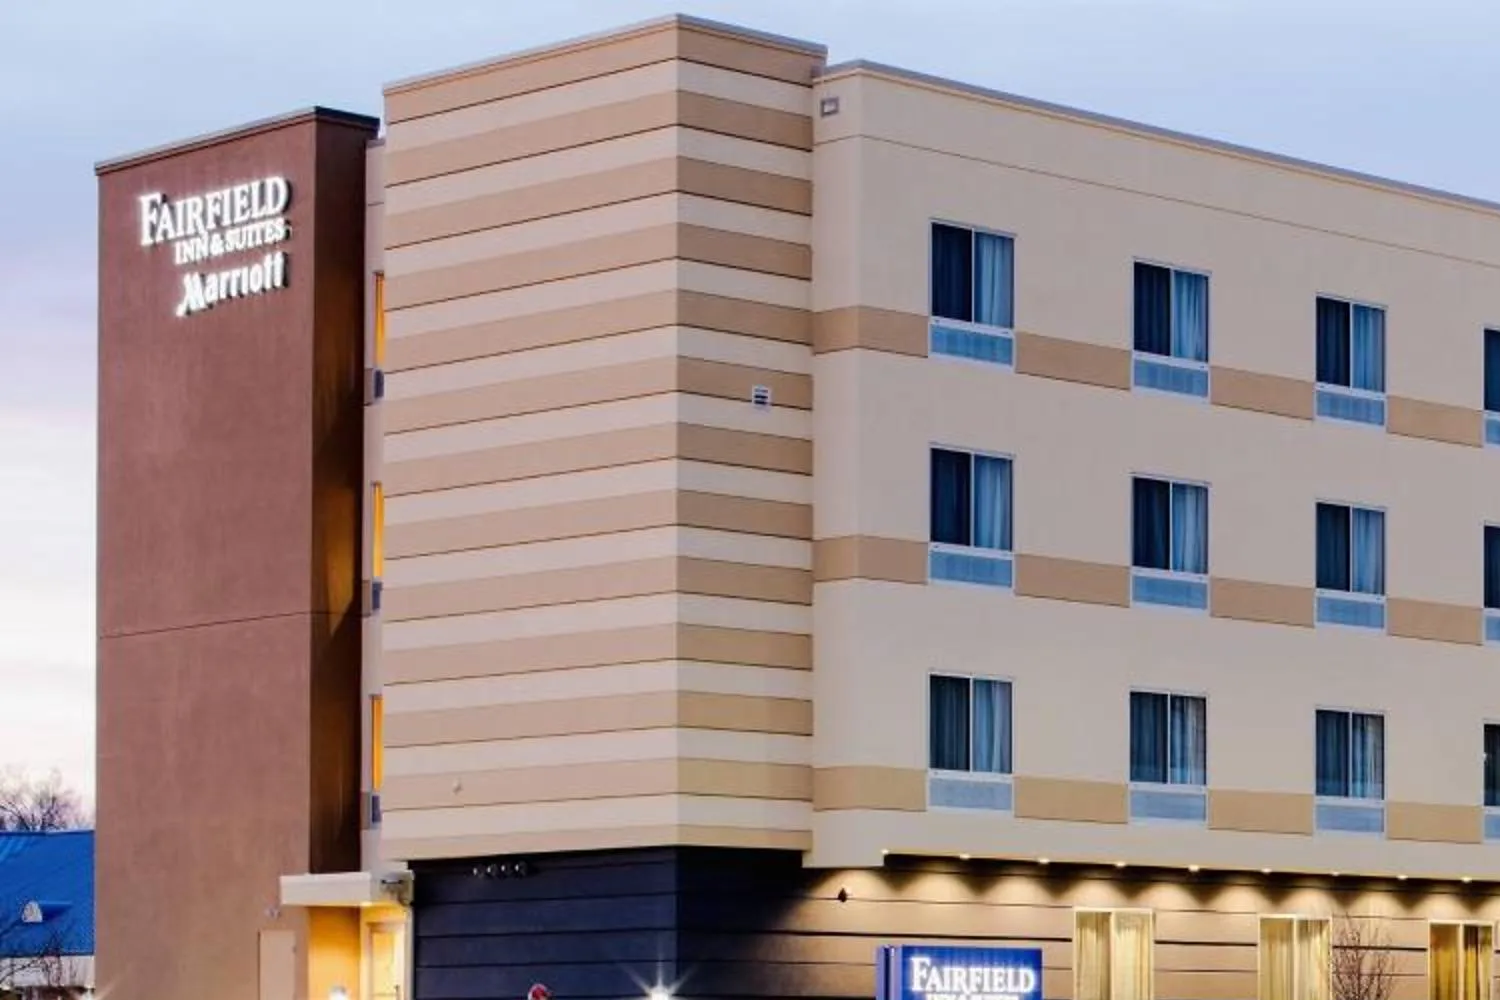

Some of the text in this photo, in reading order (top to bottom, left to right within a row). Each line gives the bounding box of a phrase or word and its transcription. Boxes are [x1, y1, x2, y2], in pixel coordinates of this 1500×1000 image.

[138, 176, 288, 246] FAIRFIELD
[175, 251, 285, 317] Marriott
[910, 956, 1036, 994] FAIRFIELD
